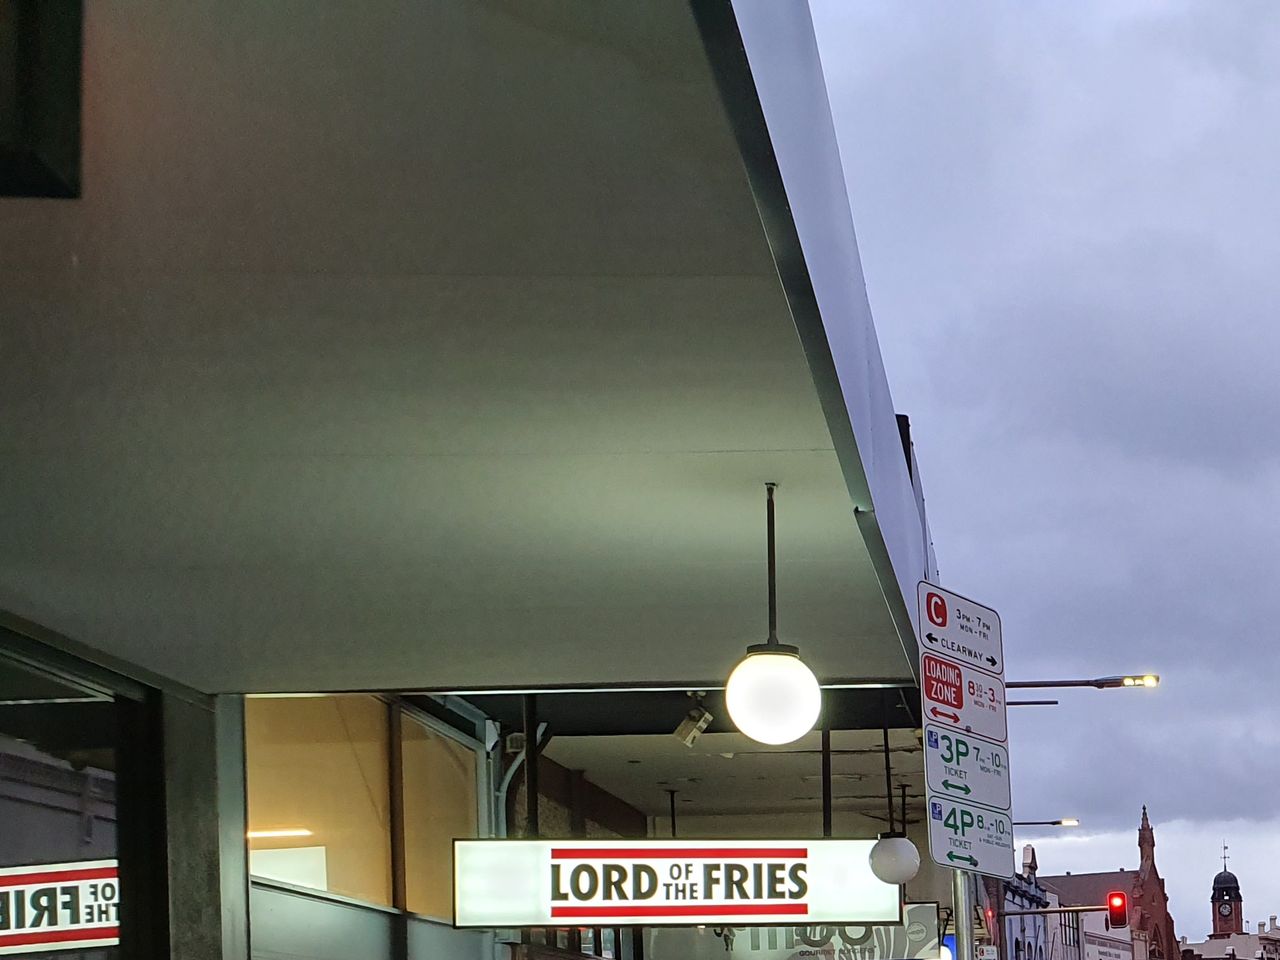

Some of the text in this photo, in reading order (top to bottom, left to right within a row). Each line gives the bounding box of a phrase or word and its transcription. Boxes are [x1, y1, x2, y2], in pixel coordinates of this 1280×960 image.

[931, 596, 943, 624] C
[941, 638, 983, 660] CLEARWAY
[926, 659, 960, 686] LOADING
[931, 681, 958, 705] ZONE
[940, 735, 969, 766] 3P
[944, 765, 968, 780] TICKET
[943, 807, 974, 837] 4P
[948, 836, 972, 851] TICKET
[551, 863, 808, 901] LORD OF THE FRIES
